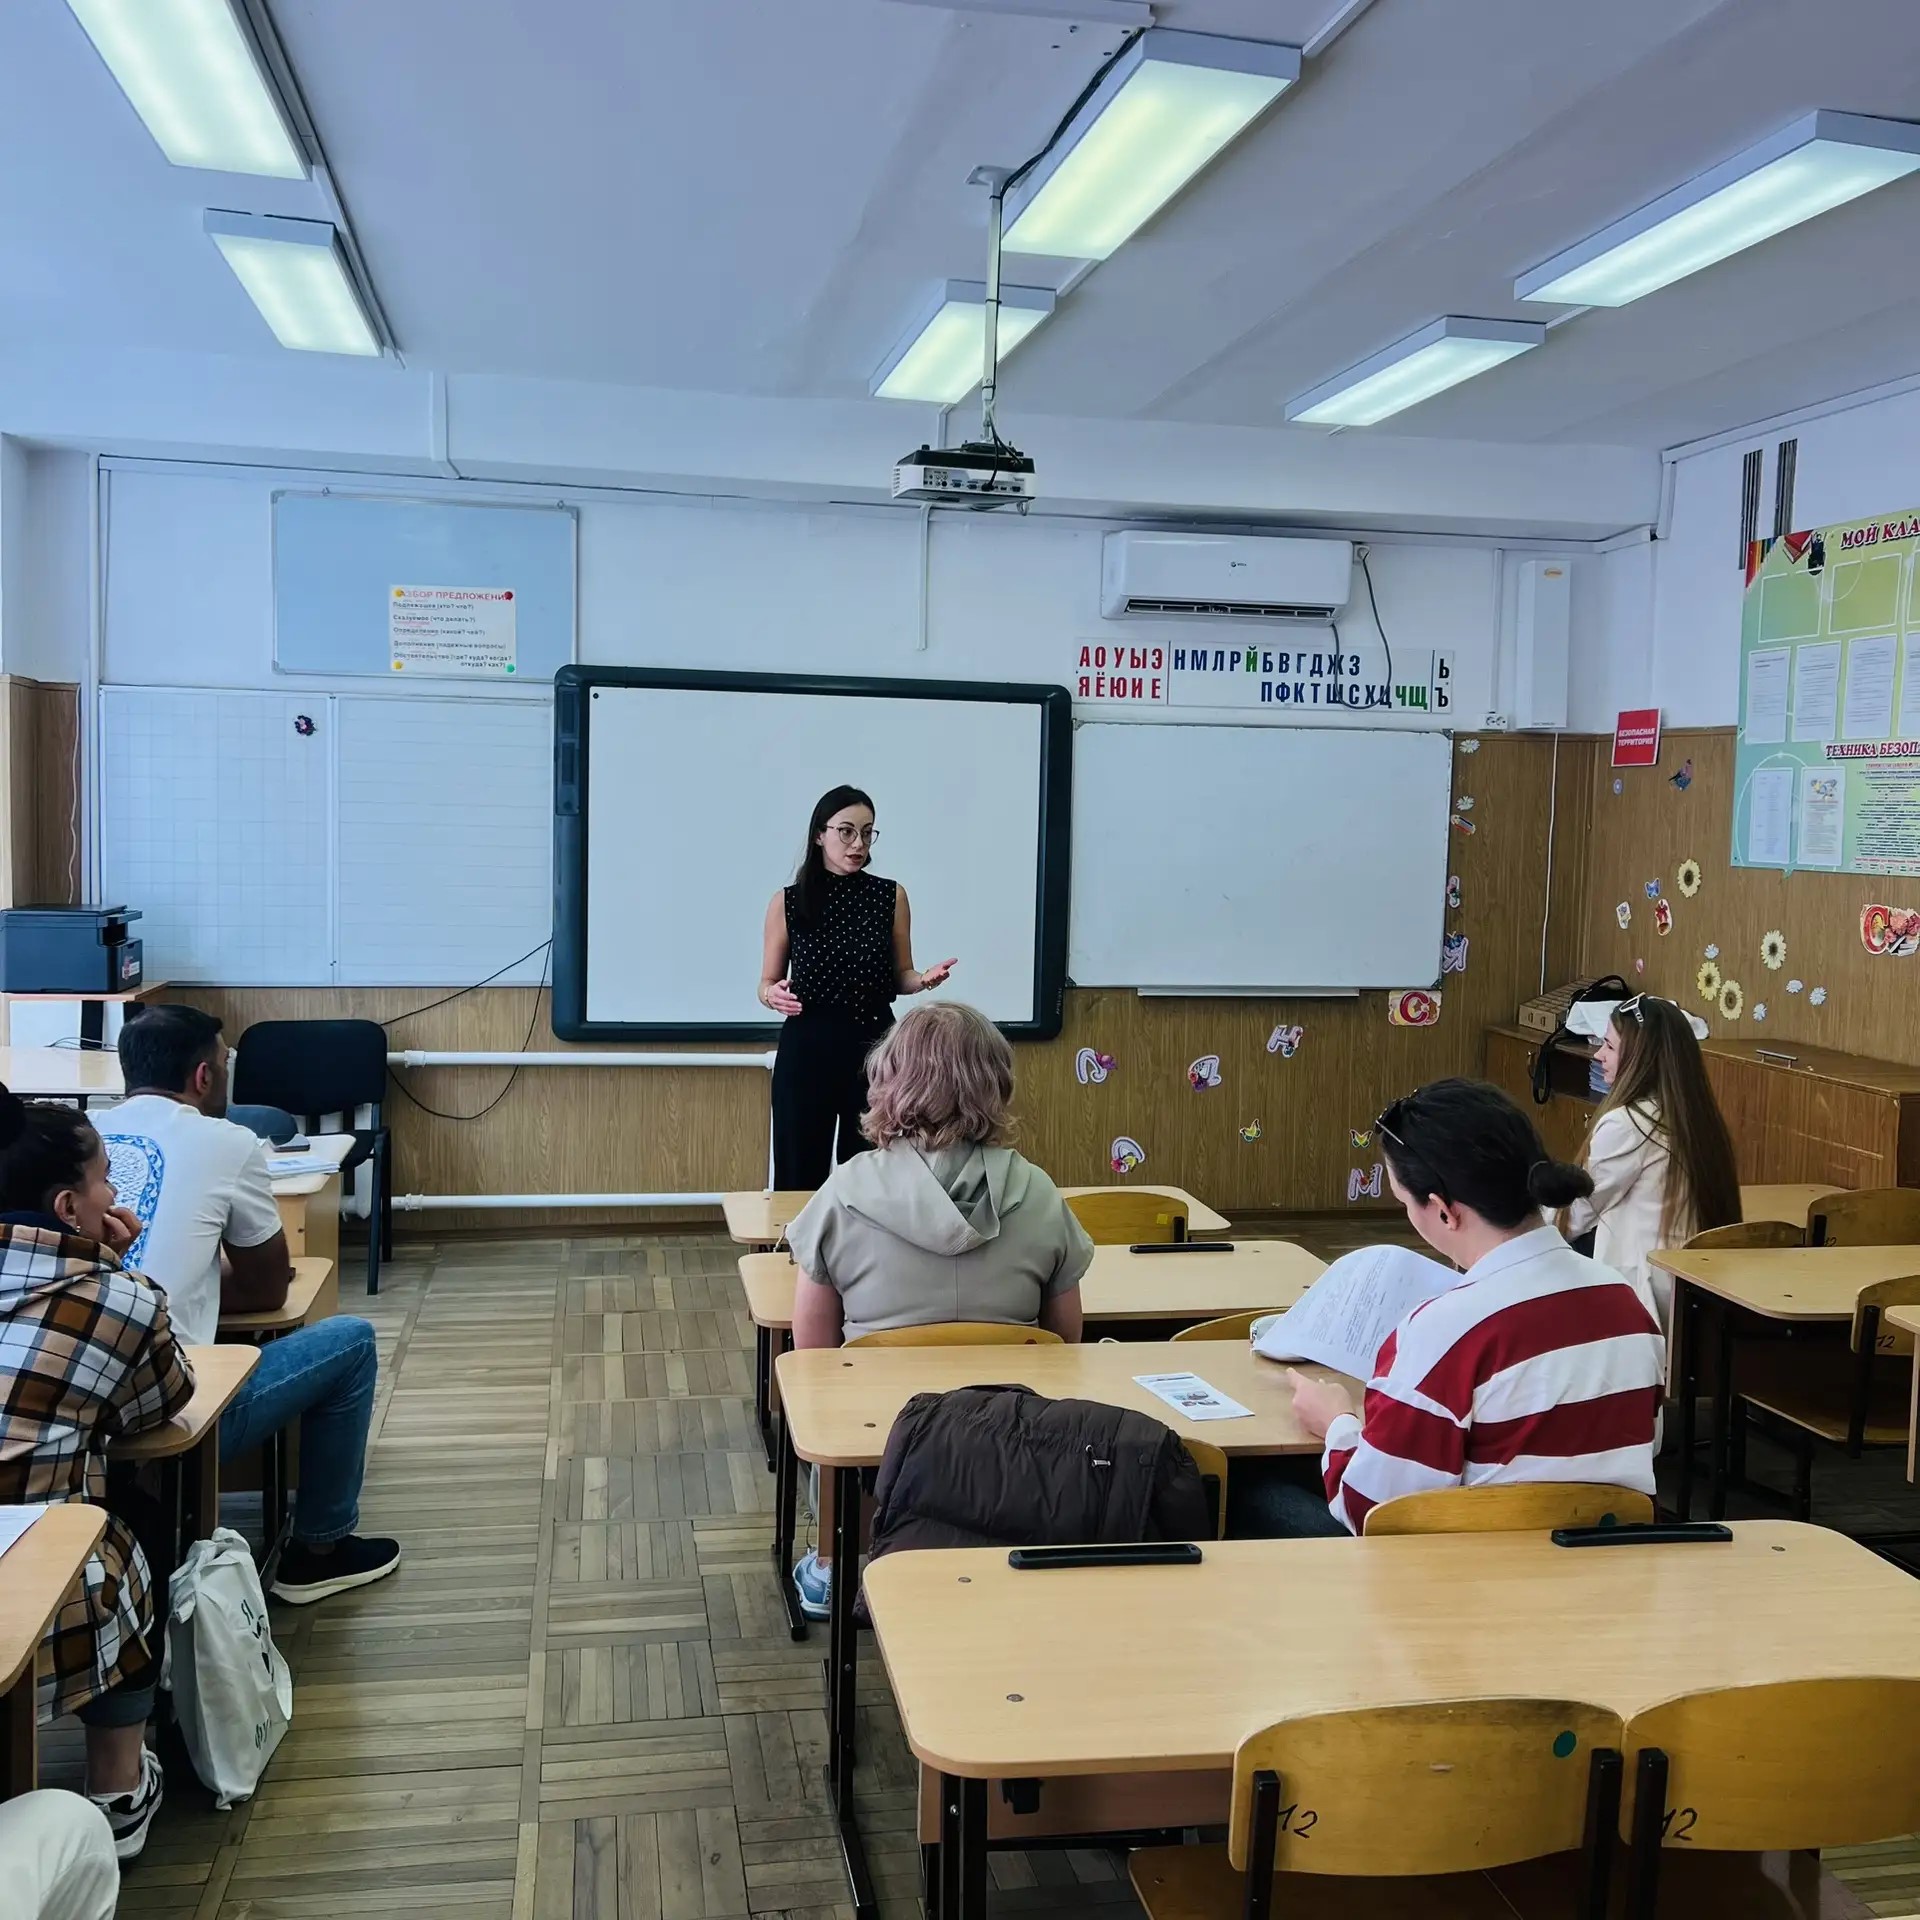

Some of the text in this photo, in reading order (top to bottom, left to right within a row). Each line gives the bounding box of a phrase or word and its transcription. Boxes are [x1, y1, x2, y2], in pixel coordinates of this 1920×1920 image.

[1840, 522, 1878, 548] МОЙ
[436, 591, 506, 601] ПРЕДЛОЖЕНИ
[1618, 728, 1656, 737] БЕЗОПАСНАЯ
[1617, 737, 1654, 747] ТЕРРИТОРИЯ
[1826, 741, 1920, 758] ТЕХНИКА БЕЗОП
[1278, 1803, 1318, 1839] 12
[1661, 1807, 1698, 1841] 12
